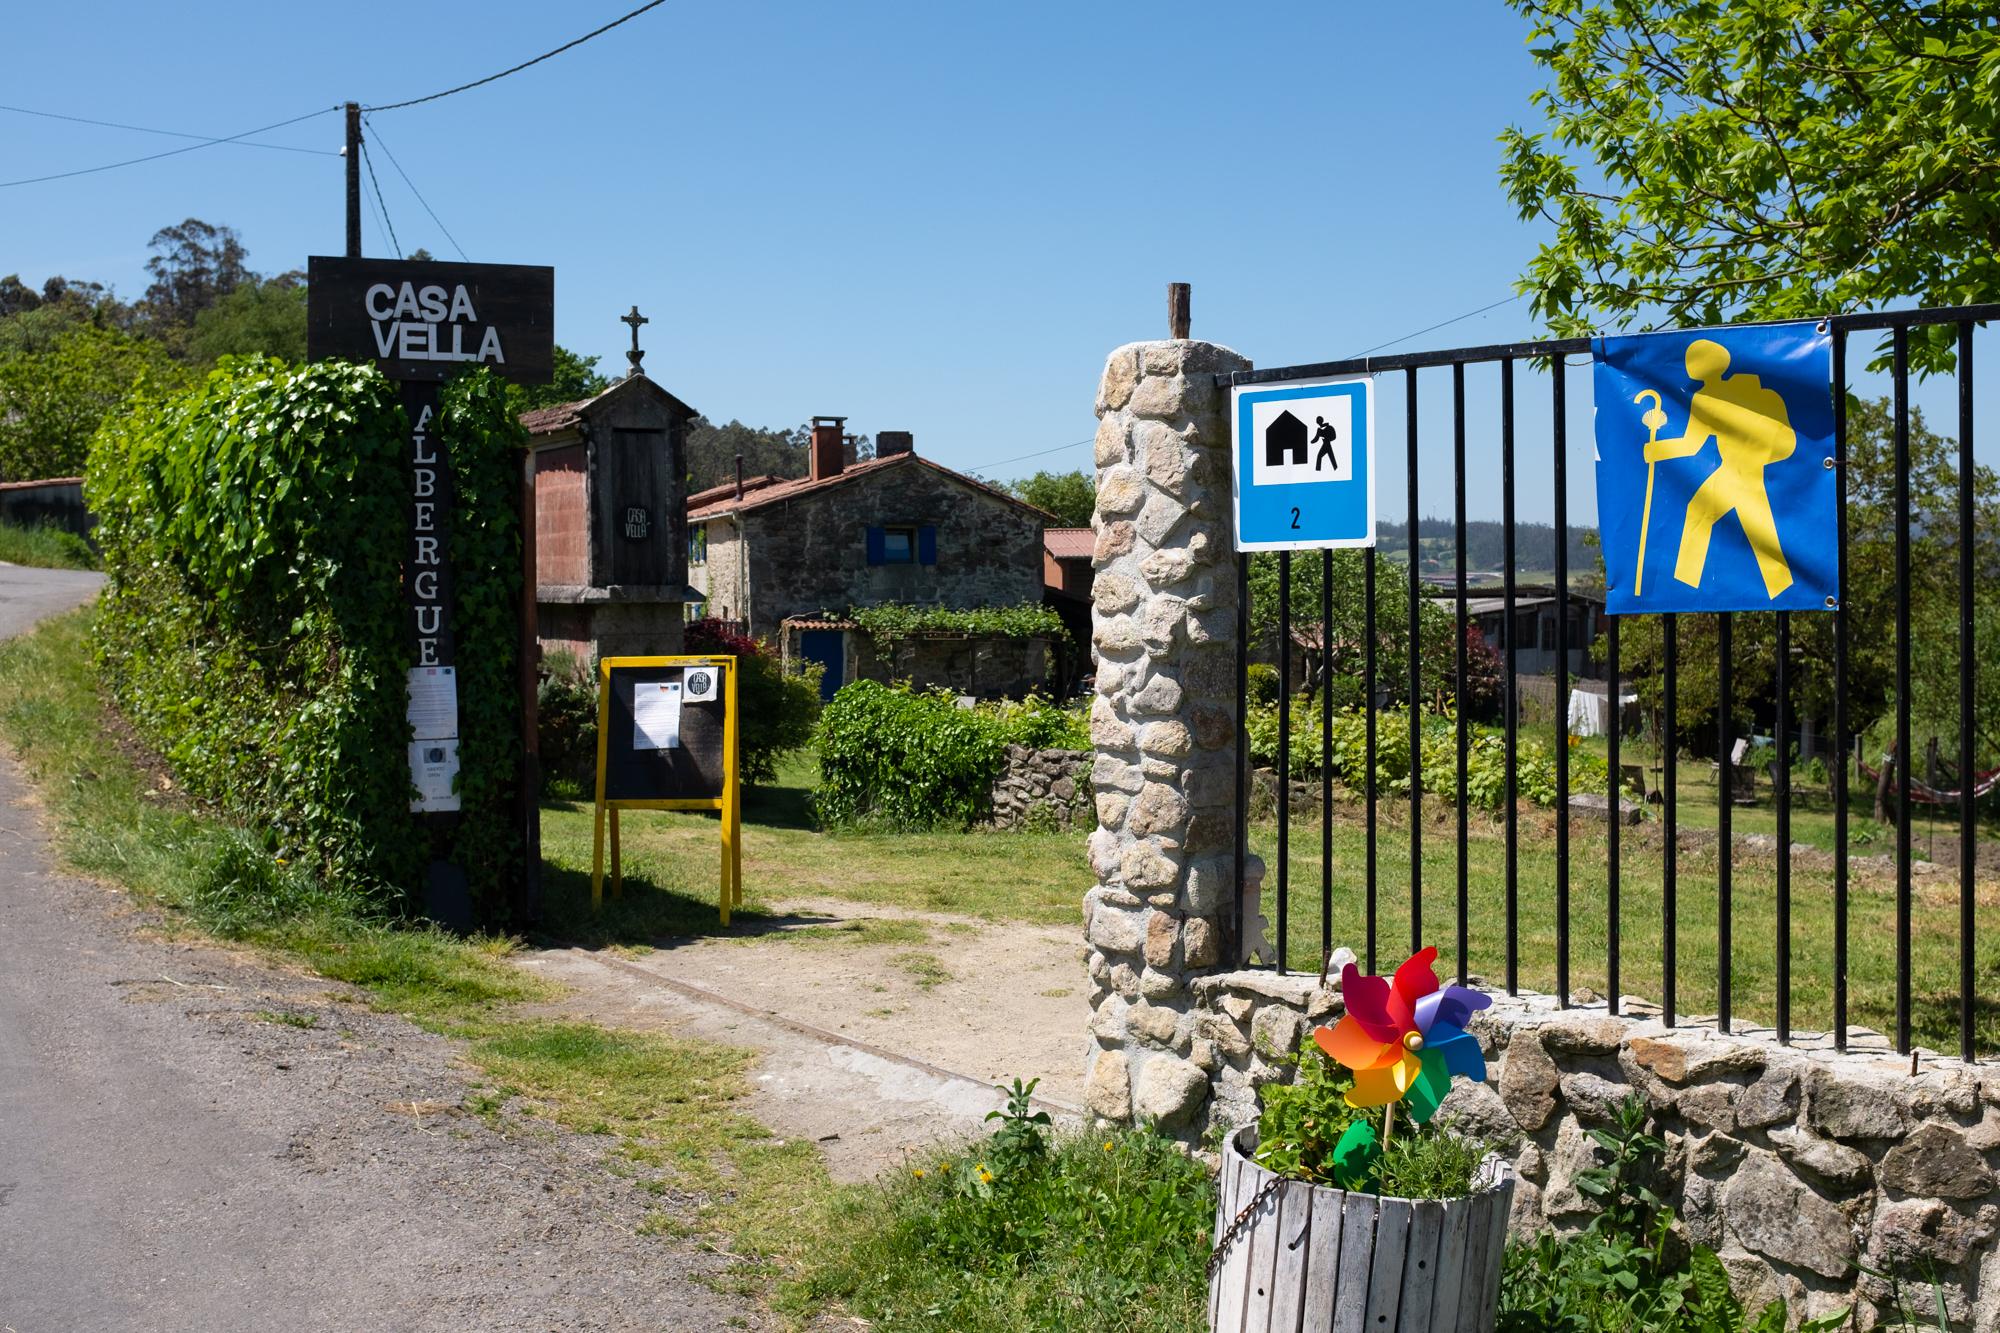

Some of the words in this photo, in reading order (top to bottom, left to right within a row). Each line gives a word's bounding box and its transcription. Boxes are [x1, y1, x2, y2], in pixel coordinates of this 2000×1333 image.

[365, 281, 477, 322] CASA
[371, 320, 505, 364] VELLA
[625, 520, 647, 538] VELLA
[628, 507, 646, 523] CASA
[1291, 507, 1301, 529] 2
[413, 404, 442, 666] ALBERGUE
